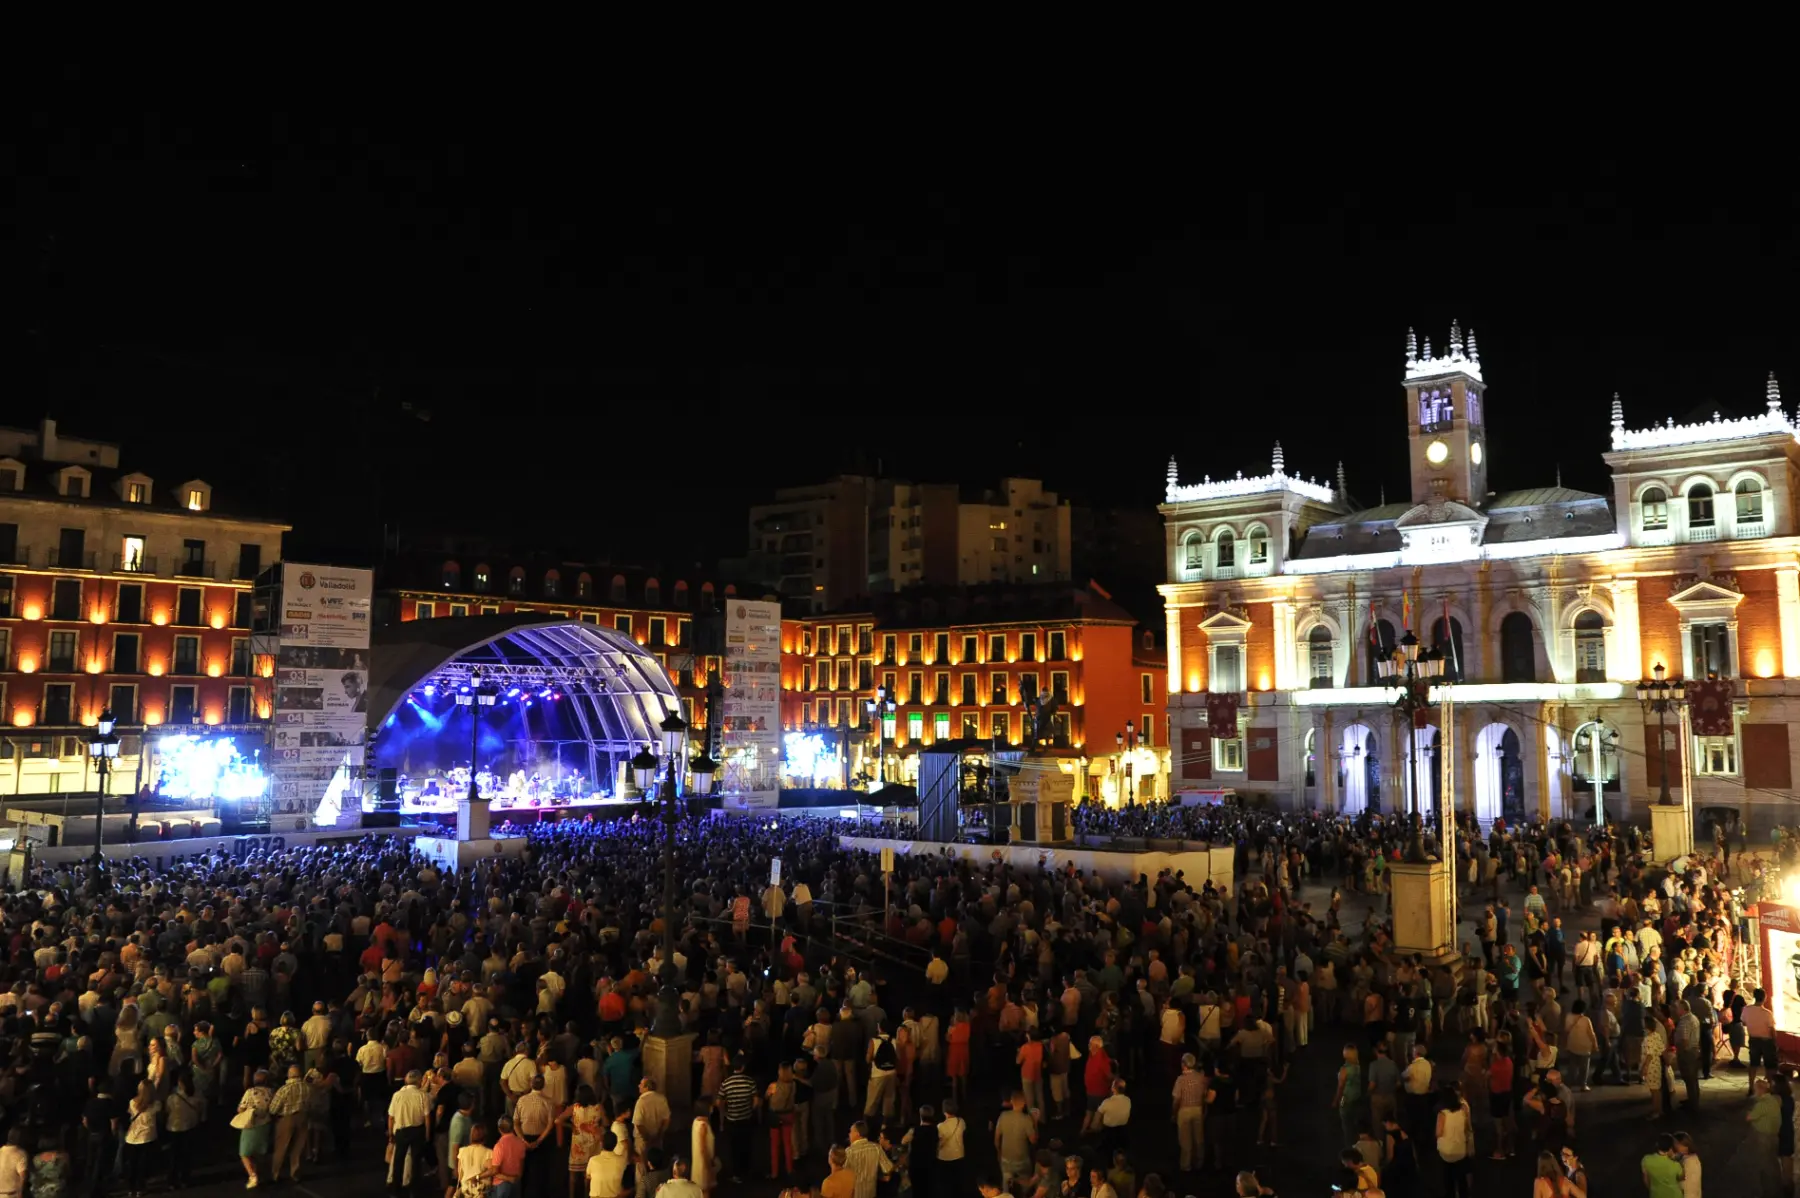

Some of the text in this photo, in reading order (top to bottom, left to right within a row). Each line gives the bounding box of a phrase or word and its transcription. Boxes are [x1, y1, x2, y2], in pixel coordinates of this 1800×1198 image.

[320, 580, 356, 591] Valladolid
[291, 625, 306, 634] 02
[289, 671, 304, 681] 03
[287, 713, 303, 723] 04
[283, 749, 298, 759] 05
[282, 783, 297, 793] 06
